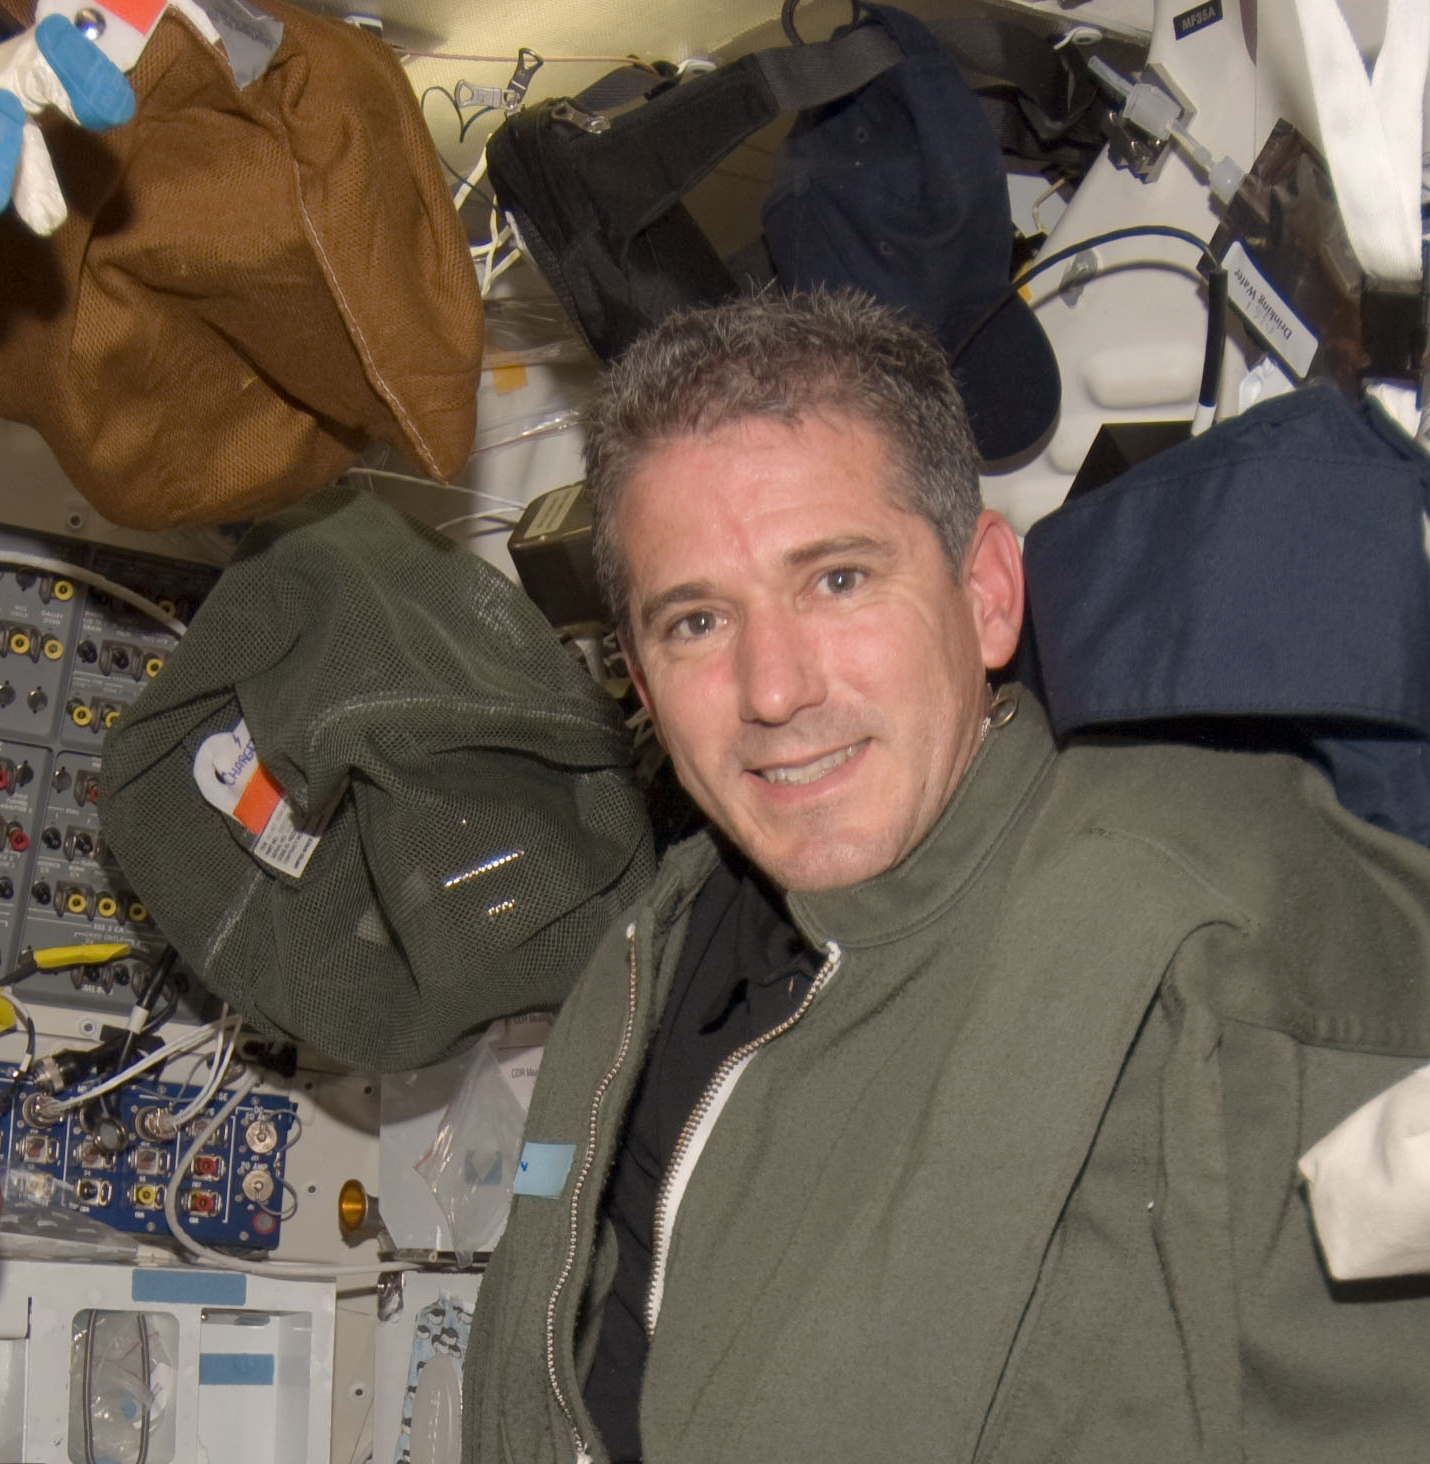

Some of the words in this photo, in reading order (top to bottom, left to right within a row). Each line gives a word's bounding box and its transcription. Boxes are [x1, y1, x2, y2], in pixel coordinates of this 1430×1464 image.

[1180, 8, 1217, 33] MF35A
[1233, 267, 1259, 298] Water
[1257, 294, 1293, 341] Drinking
